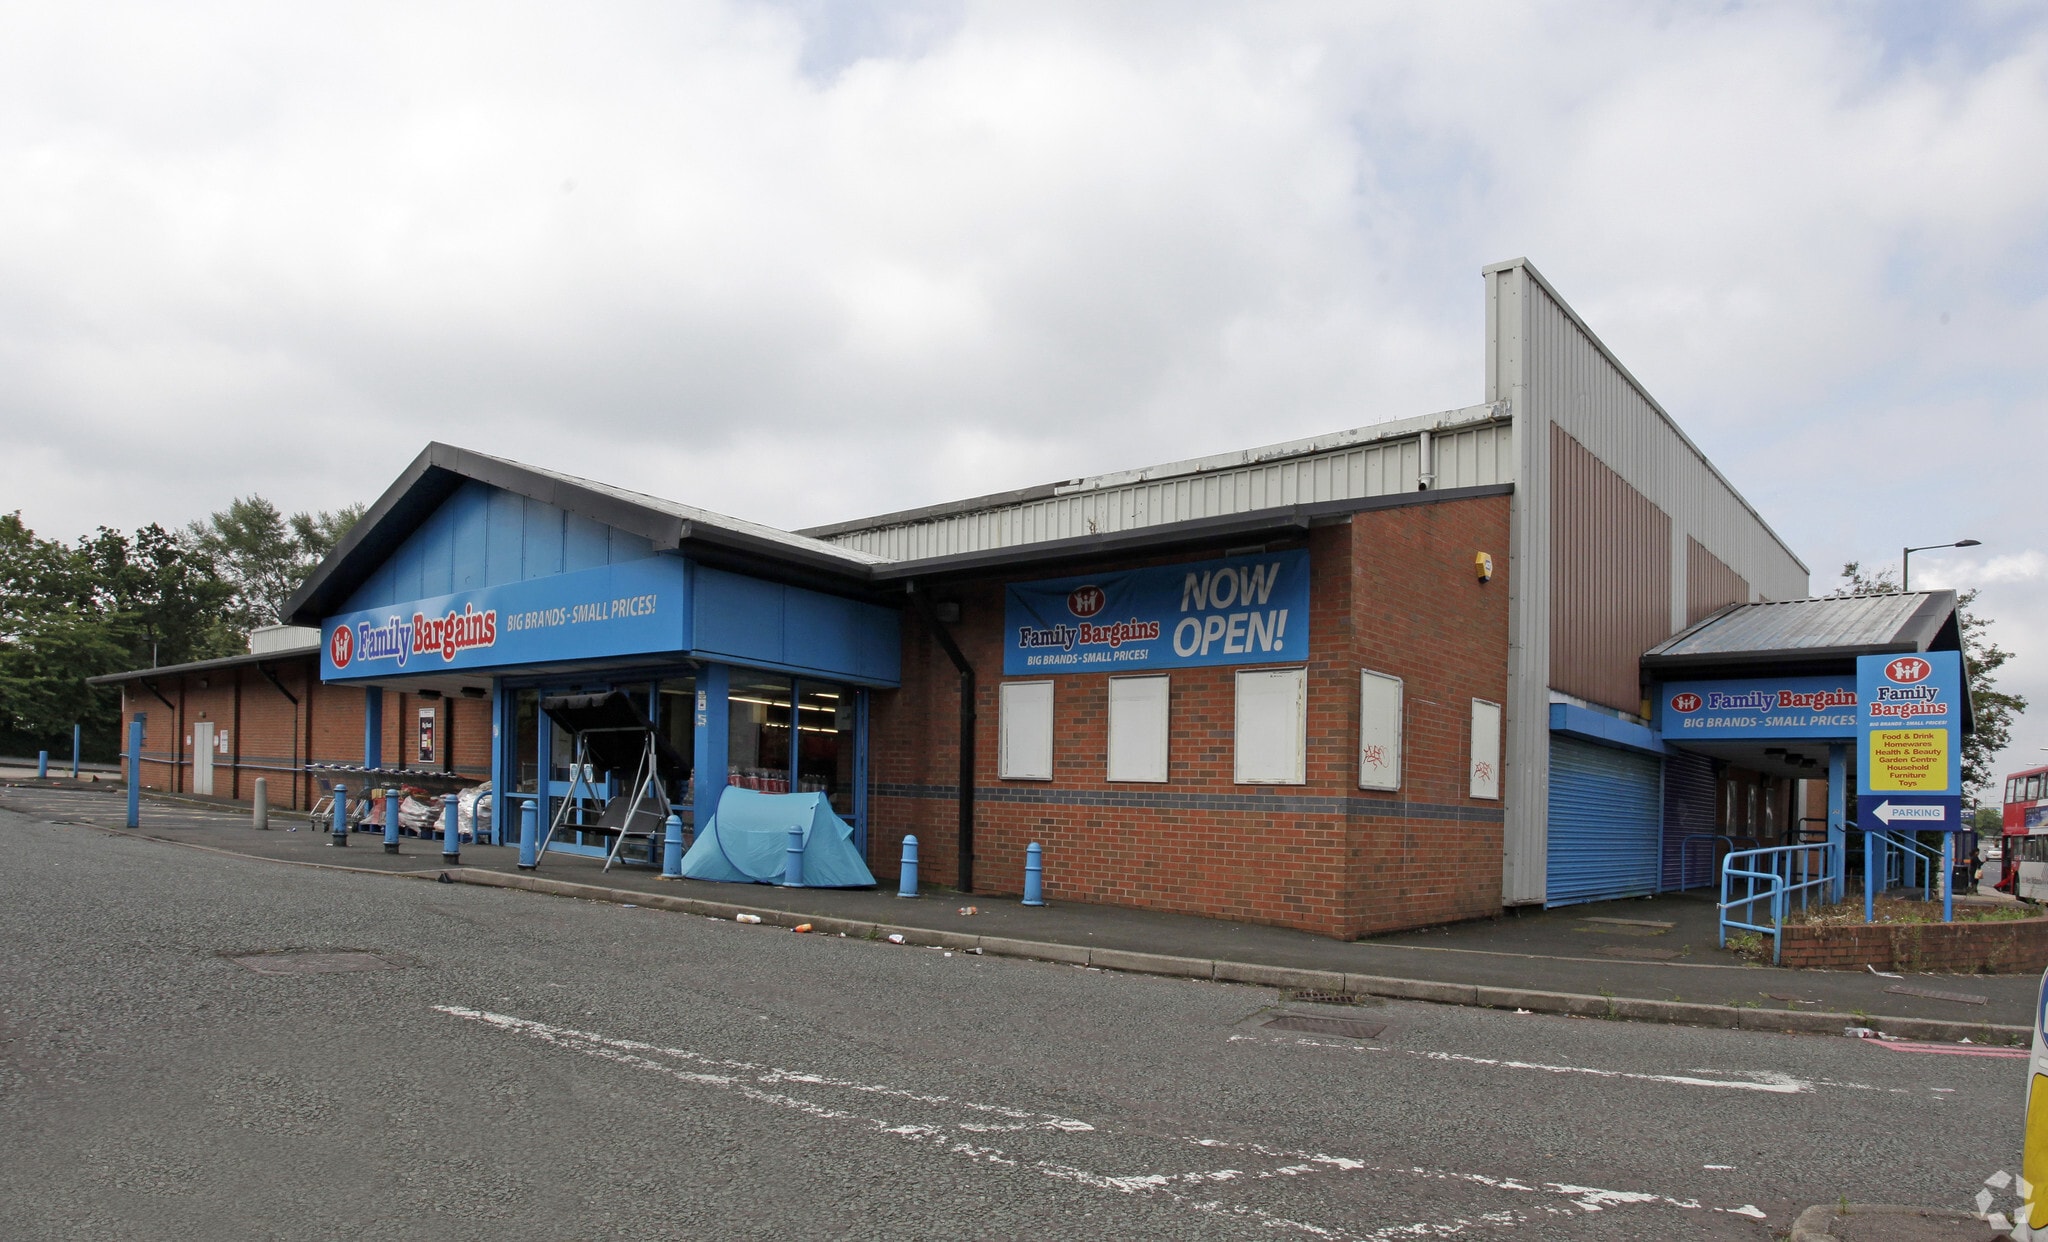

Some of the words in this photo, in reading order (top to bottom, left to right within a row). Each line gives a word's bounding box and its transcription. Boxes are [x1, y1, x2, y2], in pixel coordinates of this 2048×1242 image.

[1181, 563, 1280, 612] NOW
[507, 613, 523, 632] BIG
[525, 607, 566, 630] BRANDS
[572, 602, 609, 624] SMALL
[611, 594, 657, 619] PRICES!
[358, 616, 411, 667] Family
[413, 602, 496, 662] Bargains
[1019, 624, 1077, 651] Family
[1079, 617, 1160, 648] Bargains
[1173, 609, 1288, 657] OPEN!
[1027, 655, 1041, 665] BIG
[1043, 653, 1078, 665] BRANDS
[1083, 651, 1111, 663] SMALL
[1113, 649, 1149, 662] PRICES!
[1708, 691, 1775, 713] Family
[1777, 688, 1857, 711] Bargain
[1877, 684, 1939, 702] Family
[1683, 718, 1704, 728] BIG
[1706, 717, 1757, 728] BRANDS
[1765, 716, 1807, 727] SMALL
[1809, 715, 1858, 726] PRICES
[1869, 701, 1948, 719] Bargains
[1892, 808, 1940, 817] PARKING
